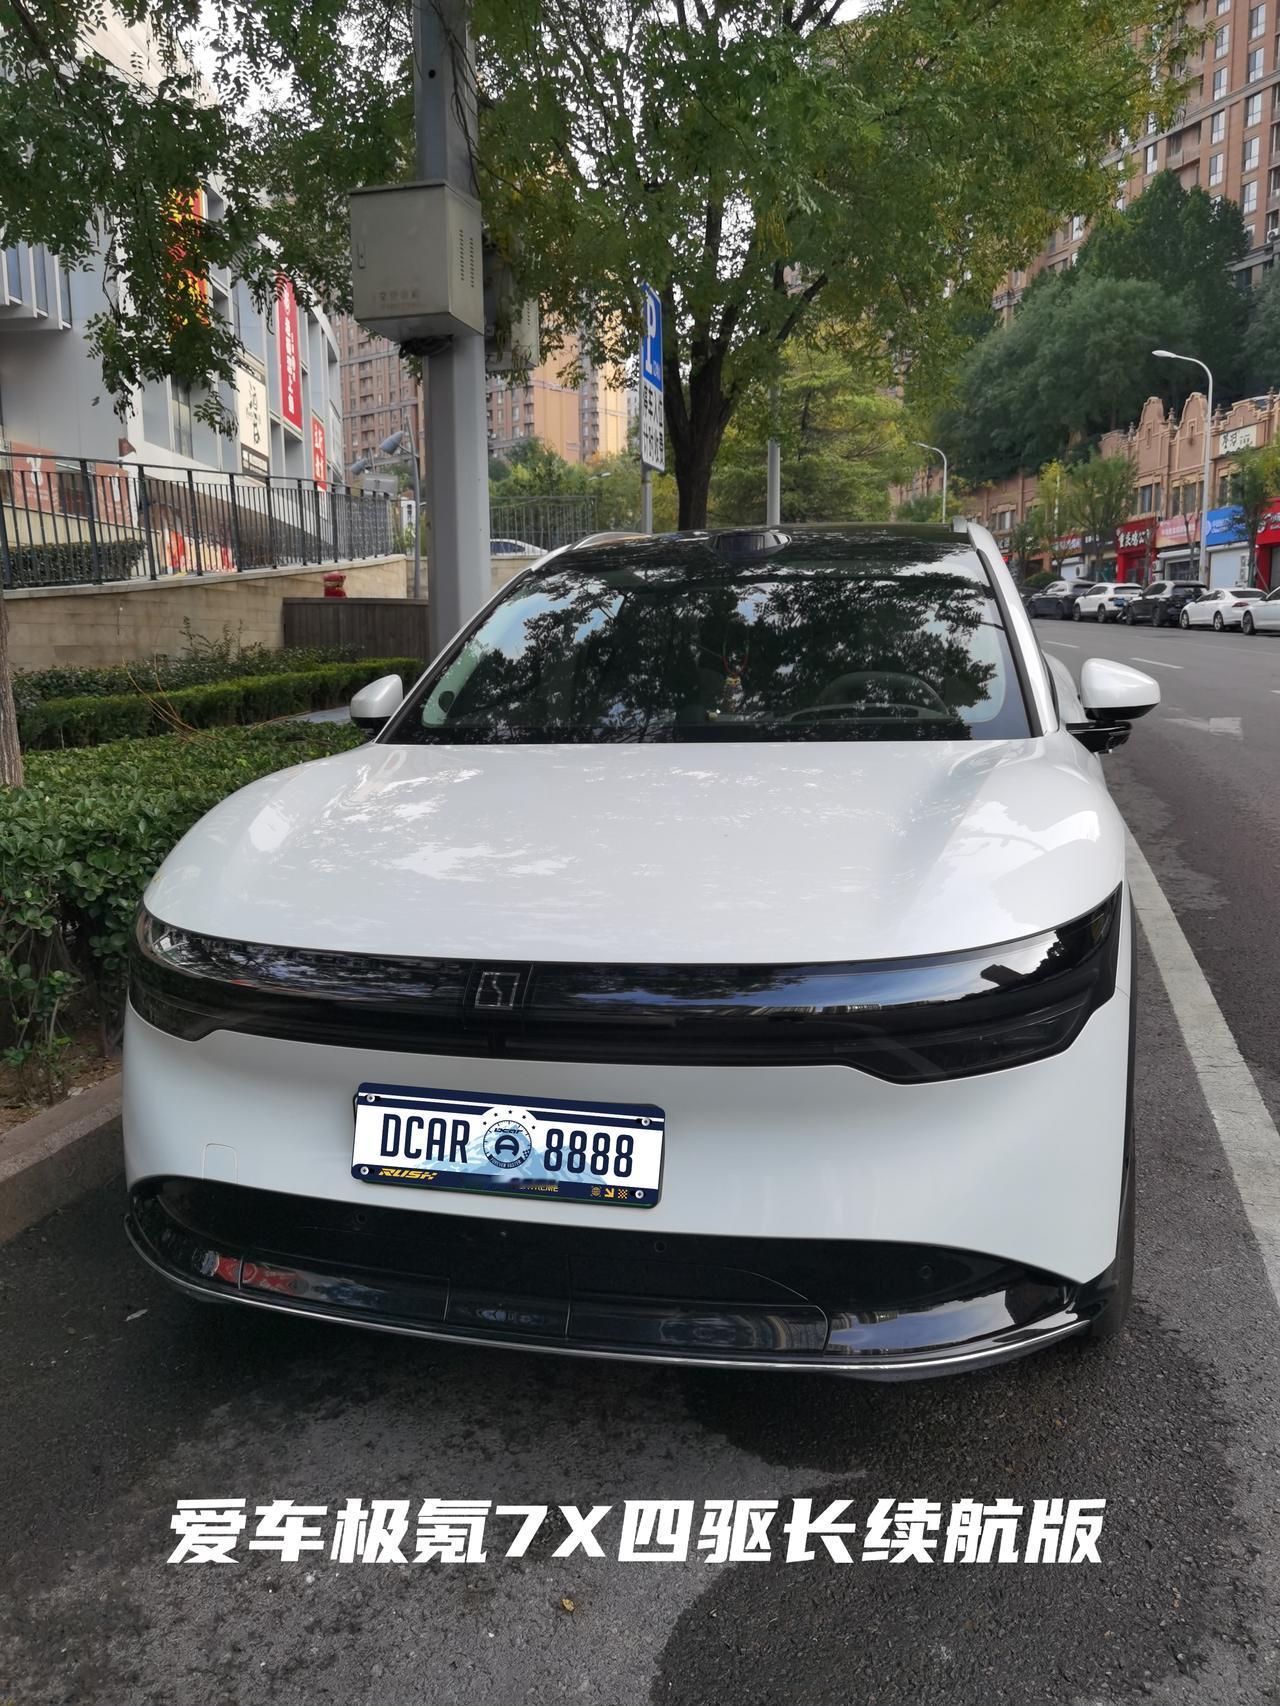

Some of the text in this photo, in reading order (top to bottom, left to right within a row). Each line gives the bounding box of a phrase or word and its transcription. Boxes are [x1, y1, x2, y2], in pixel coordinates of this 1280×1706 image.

[645, 291, 657, 375] P
[378, 1167, 439, 1180] RUSH
[380, 1113, 634, 1178] DCAR 8888
